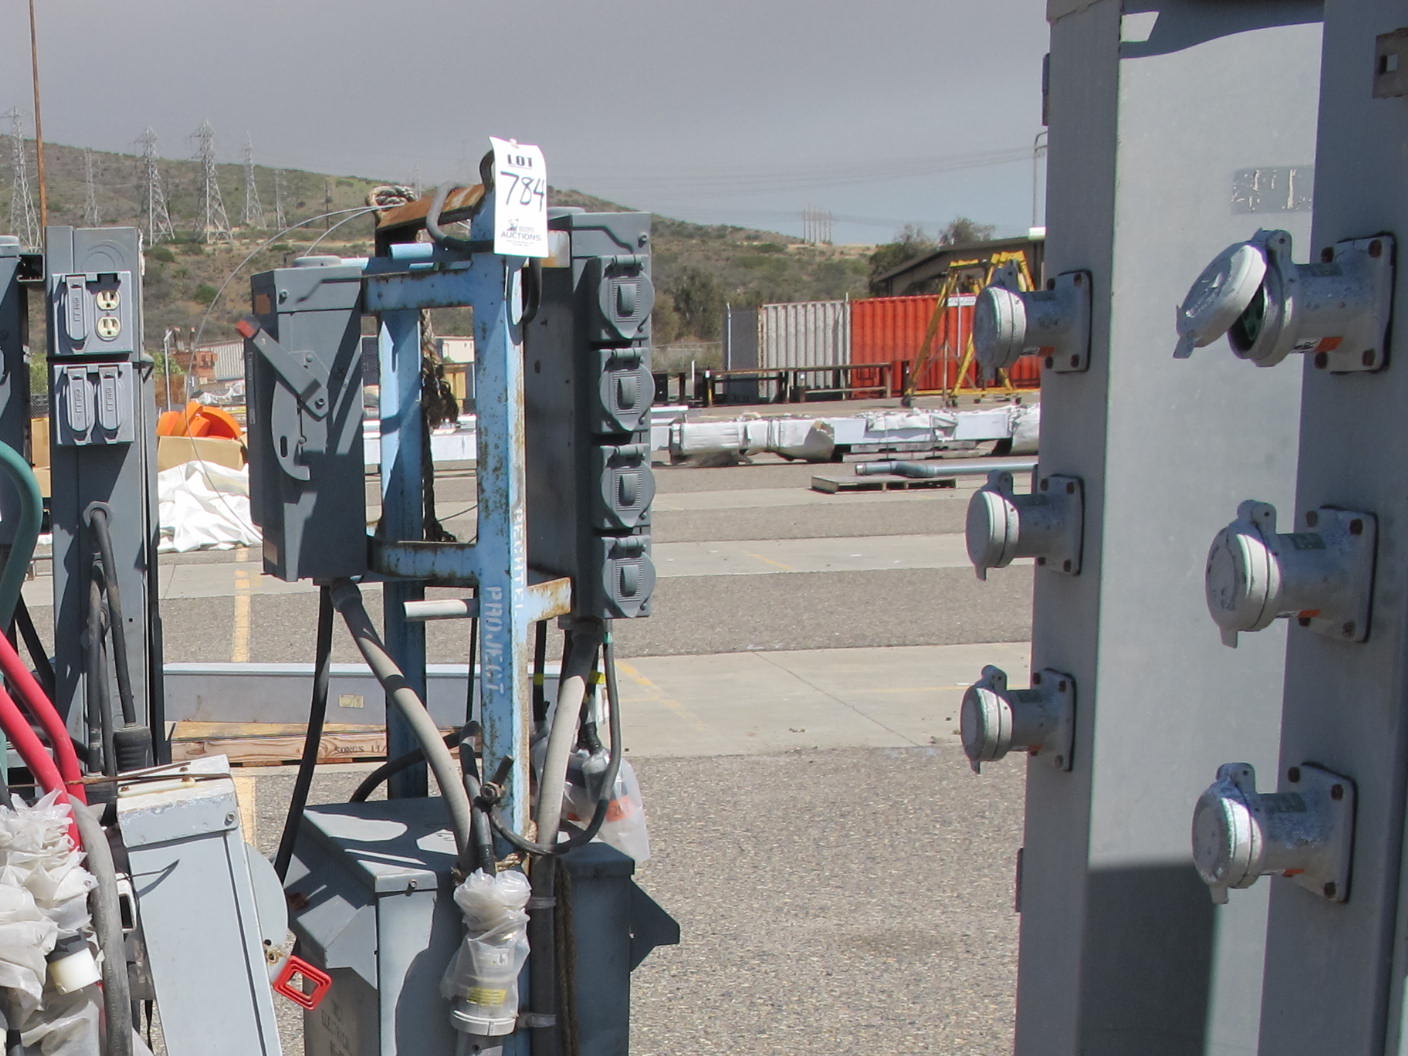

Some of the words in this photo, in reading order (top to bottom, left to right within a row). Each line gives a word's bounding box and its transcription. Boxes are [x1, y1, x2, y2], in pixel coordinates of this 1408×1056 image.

[506, 153, 533, 168] LOT
[500, 170, 545, 213] 784
[500, 230, 542, 242] AUCTIONS
[484, 586, 505, 695] PROJECT
